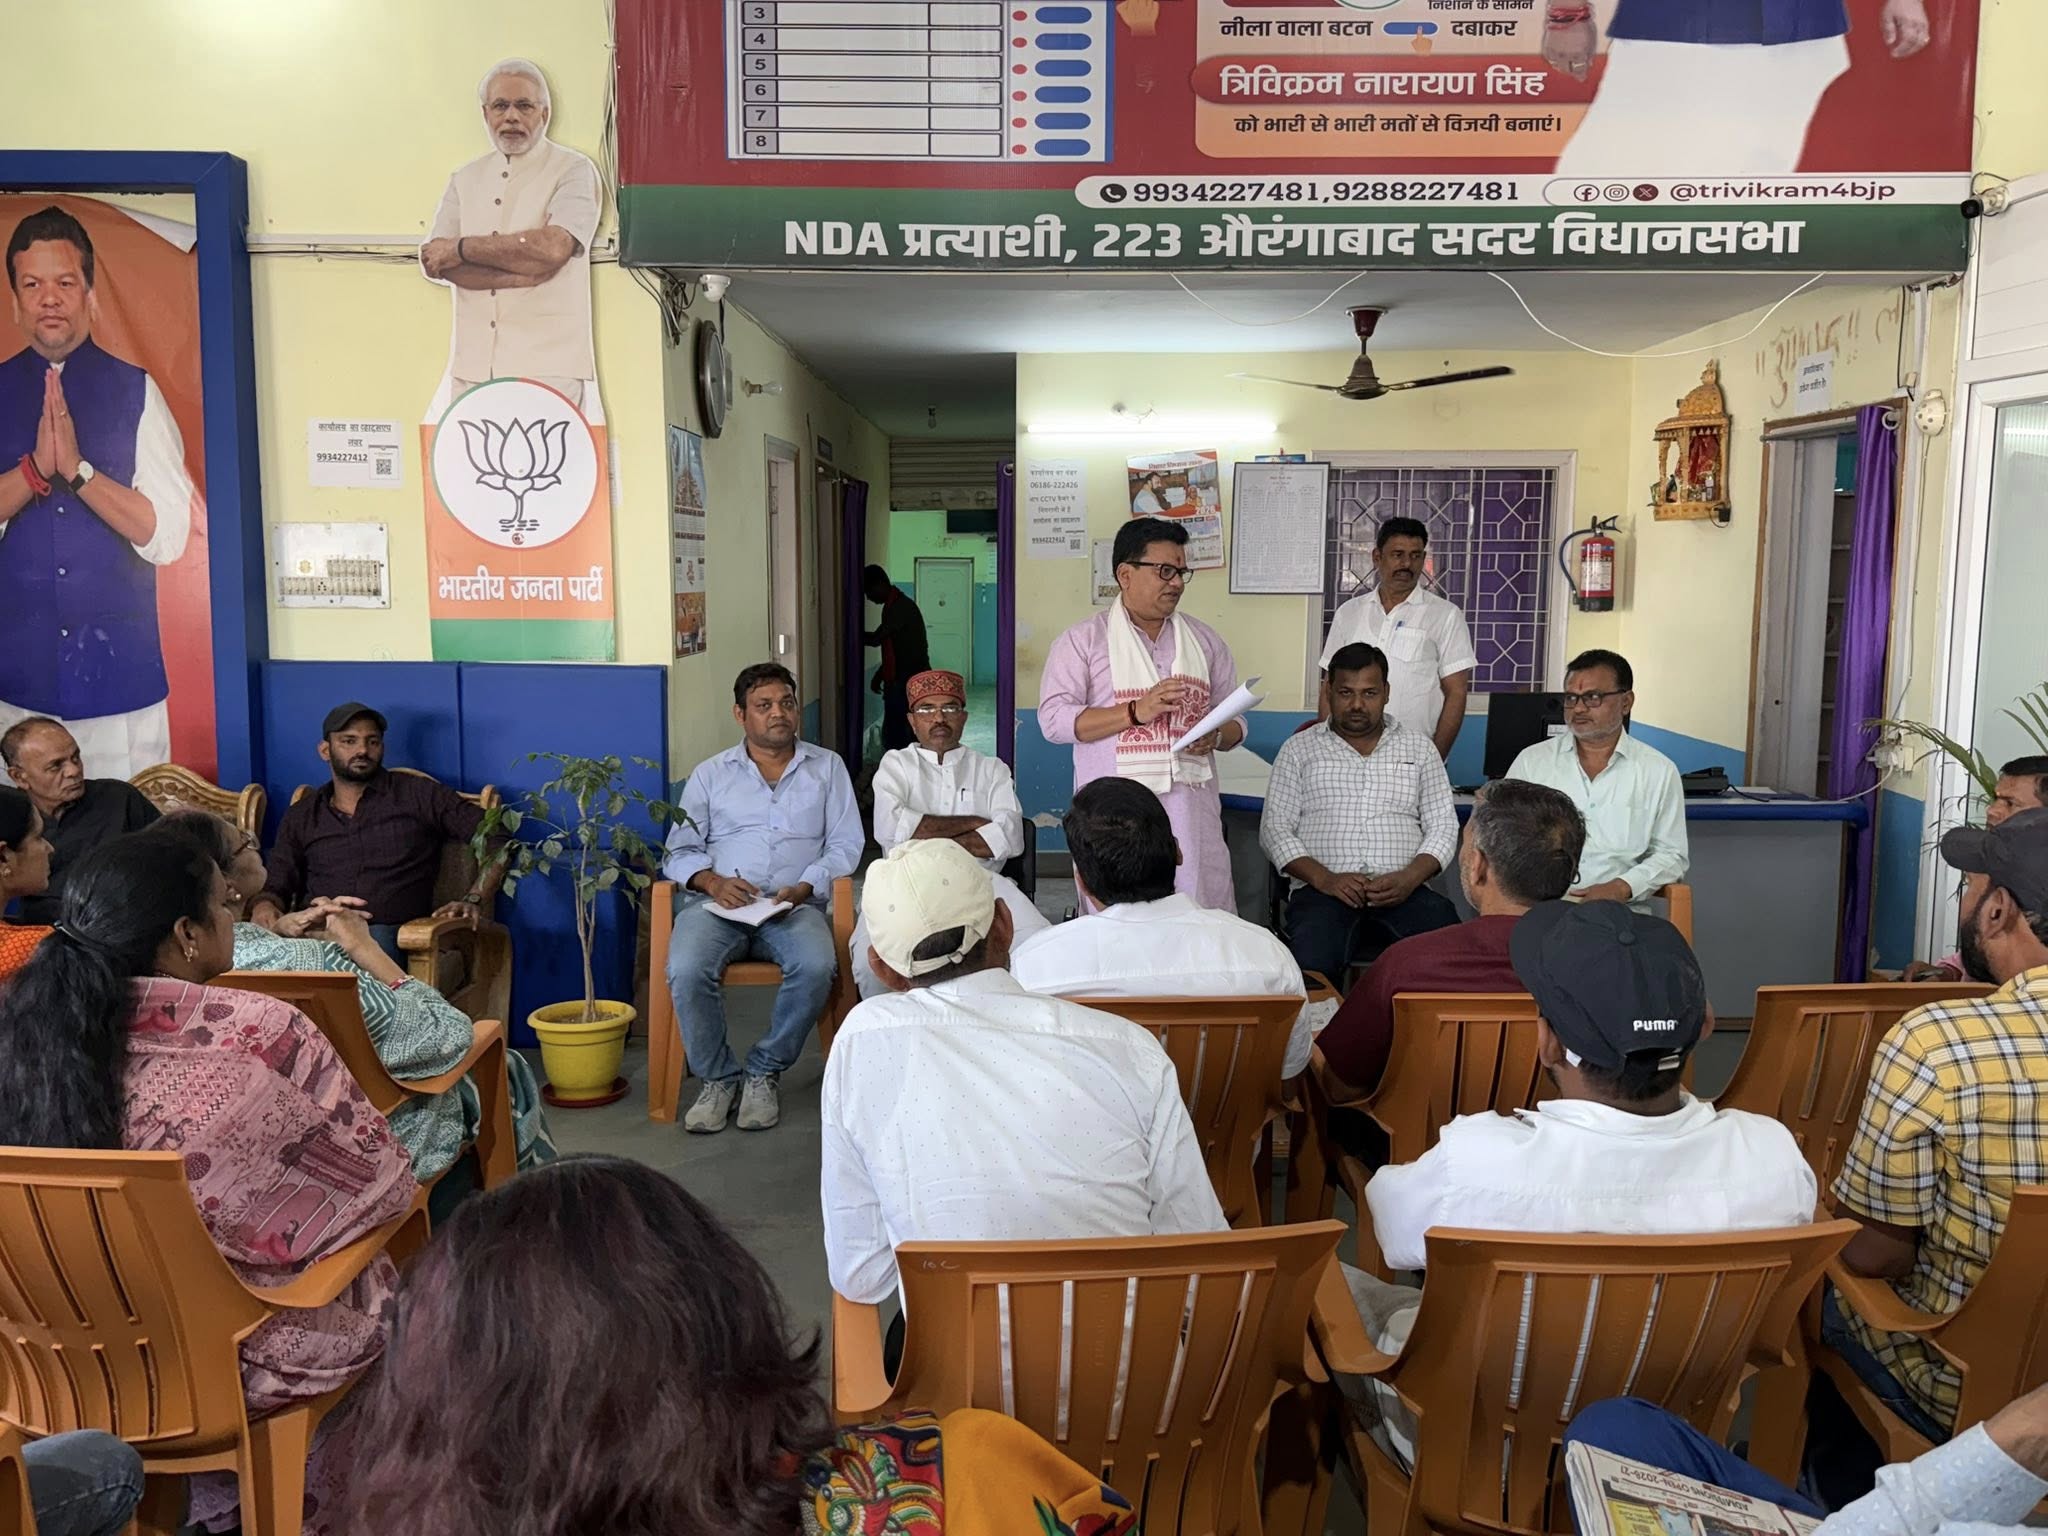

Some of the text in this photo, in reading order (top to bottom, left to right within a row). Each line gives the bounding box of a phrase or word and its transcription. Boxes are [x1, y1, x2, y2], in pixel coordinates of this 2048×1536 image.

[754, 7, 765, 19] 3
[1219, 16, 1519, 37] नीला वाला बटन दबाकर
[754, 33, 766, 45] 4
[755, 59, 766, 70] 5
[1219, 63, 1548, 96] त्रिविक्रम नारायण सिंह
[755, 84, 766, 96] 6
[755, 110, 766, 121] 7
[1234, 114, 1259, 133] को
[1264, 113, 1306, 133] भारी
[1309, 113, 1329, 133] से
[1334, 113, 1376, 133] भारी
[1380, 114, 1419, 133] मतों
[1421, 113, 1441, 133] से
[1443, 113, 1500, 133] विजयी
[756, 135, 767, 147] 8
[1133, 180, 1520, 204] 9934227481,9288227481
[1669, 180, 1896, 202] @trivikram4bjp
[785, 211, 1806, 264] NDA प्रत्याशी, 223 औरंगाबाद सदर विधानसभा
[316, 453, 368, 463] 9934227412
[438, 565, 604, 602] भारतीय जनता पार्टी
[1632, 1019, 1676, 1032] PUMA
